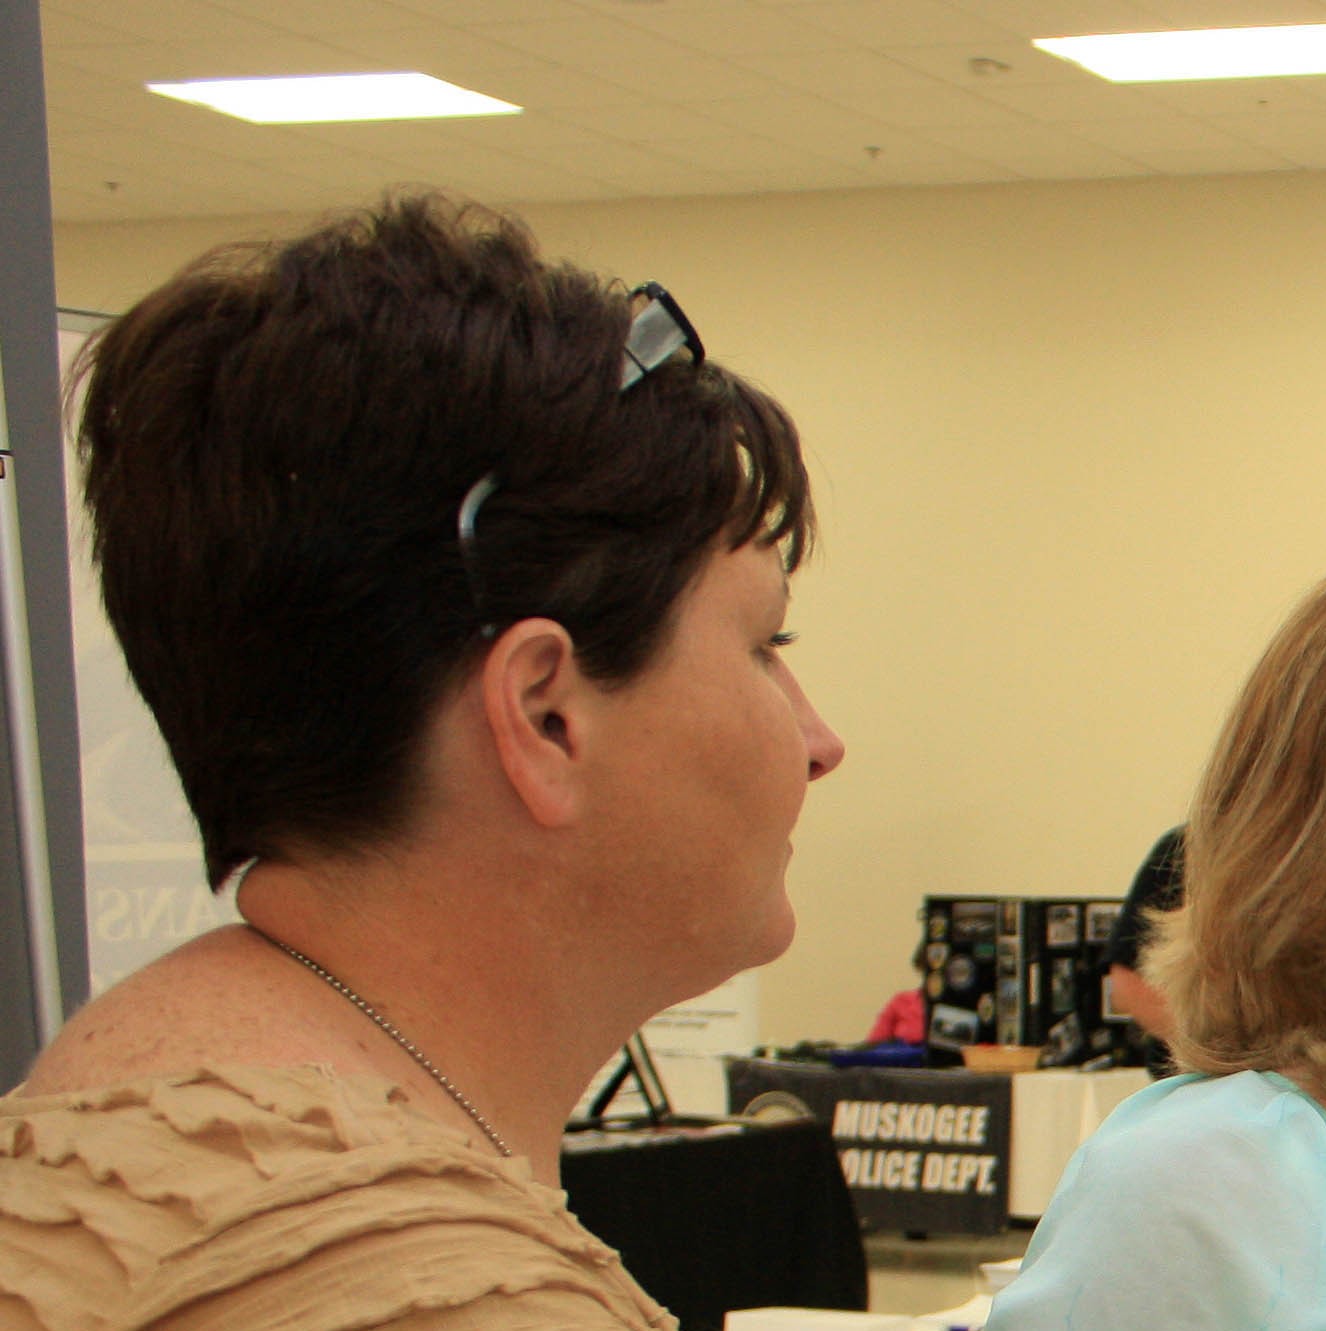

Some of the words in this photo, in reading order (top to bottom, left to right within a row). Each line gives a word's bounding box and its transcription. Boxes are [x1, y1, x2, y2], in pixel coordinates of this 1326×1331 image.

[832, 1100, 990, 1145] MUSKOGEE
[841, 1148, 918, 1191] OLICE
[922, 1152, 998, 1195] DEPT.
